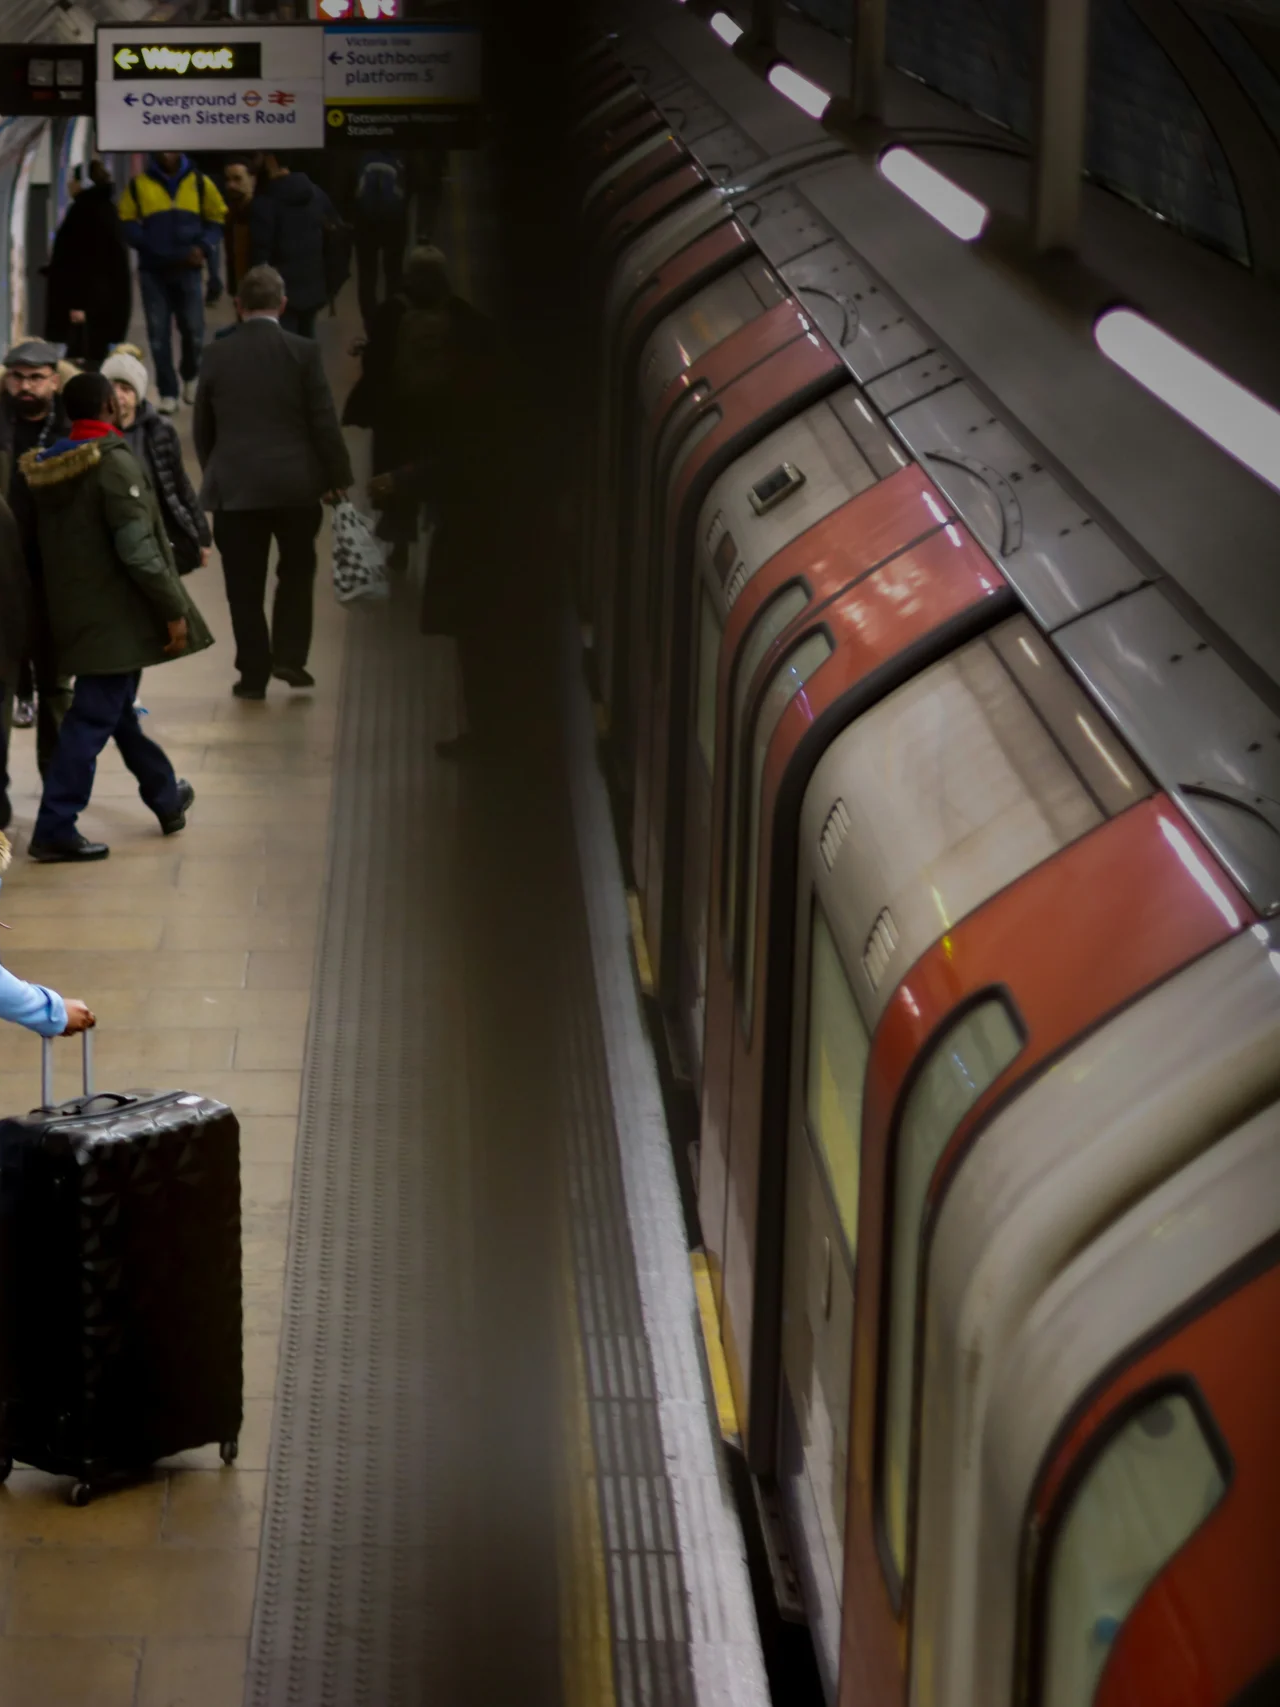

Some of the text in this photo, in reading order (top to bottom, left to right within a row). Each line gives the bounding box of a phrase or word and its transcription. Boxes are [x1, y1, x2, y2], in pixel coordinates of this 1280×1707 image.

[141, 46, 234, 74] Way out
[346, 51, 451, 65] Southbound
[345, 69, 418, 86] platform
[142, 92, 237, 109] Overground
[142, 110, 296, 125] Seven Sisters Road
[346, 125, 394, 136] Stadium
